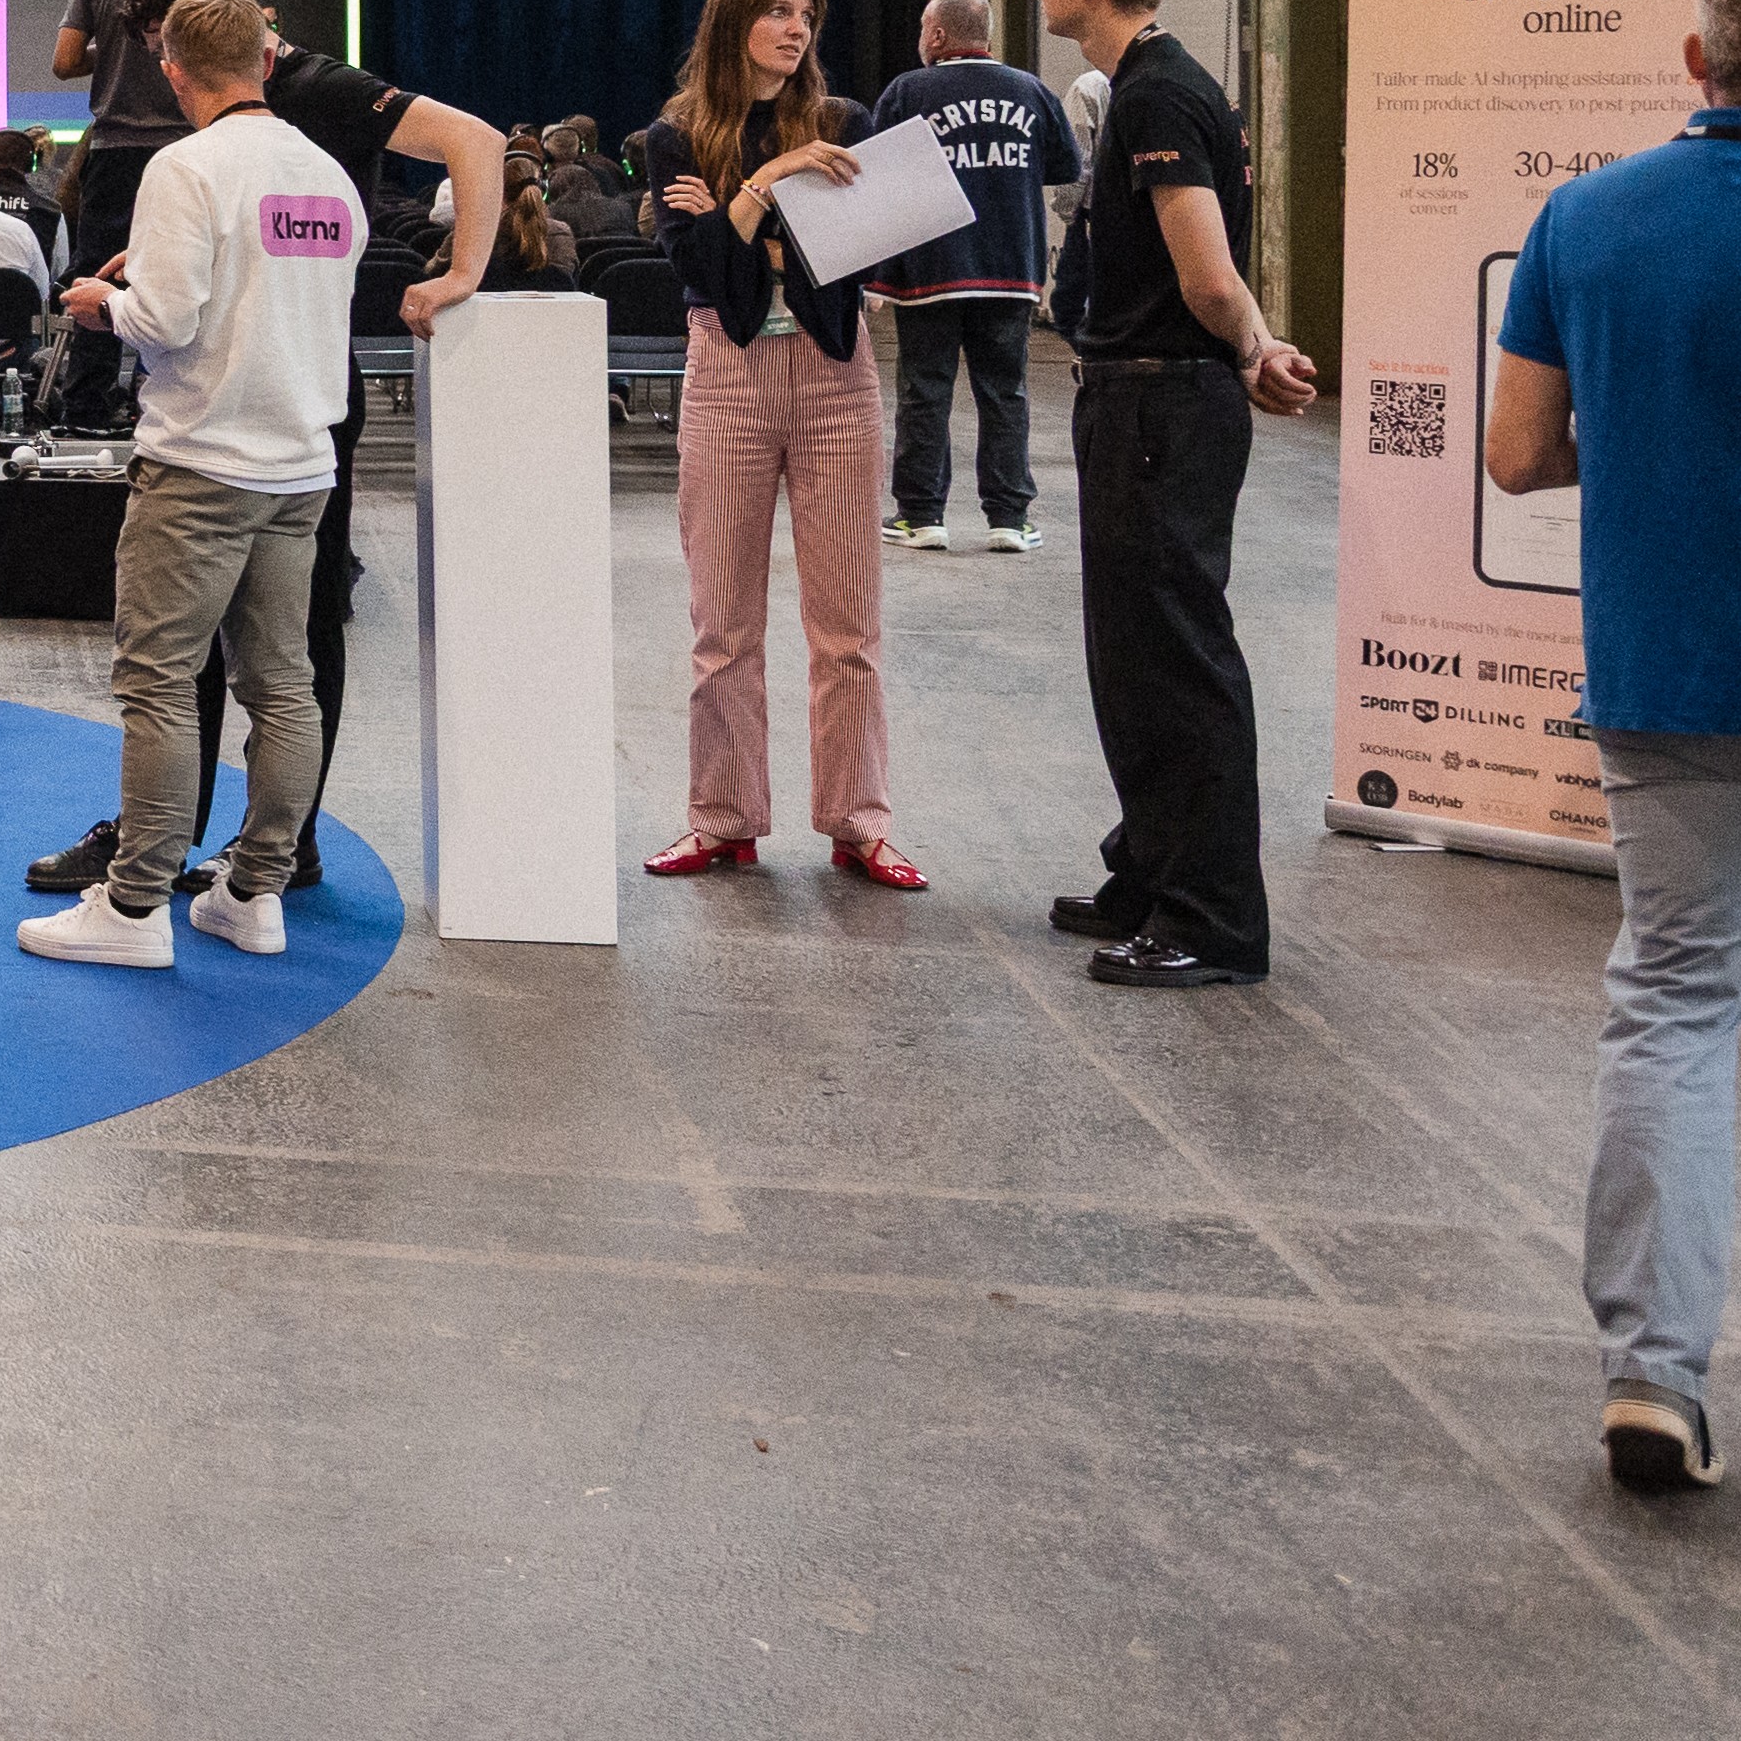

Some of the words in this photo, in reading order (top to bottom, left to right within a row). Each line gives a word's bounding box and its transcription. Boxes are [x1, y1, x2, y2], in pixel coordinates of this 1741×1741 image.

[1522, 4, 1623, 34] online
[1492, 70, 1569, 89] shopping
[1571, 71, 1652, 87] assistants
[1655, 70, 1681, 86] for
[1376, 97, 1420, 112] From
[1423, 96, 1482, 115] product
[1486, 95, 1563, 115] discovery
[1569, 97, 1585, 111] to
[927, 99, 1037, 138] CRYSTAL
[1412, 152, 1459, 178] 18%
[1415, 185, 1469, 201] sessions
[1409, 200, 1458, 216] convert
[272, 211, 341, 242] Klarna
[1361, 638, 1464, 678] Boozt
[1360, 695, 1410, 714] SPORT
[1445, 706, 1525, 730] DILLING
[1359, 742, 1432, 764] SKORINGEN
[1466, 758, 1481, 770] dk
[1484, 762, 1539, 780] company
[1408, 789, 1464, 810] Bodylab
[1549, 809, 1609, 829] CHANG
